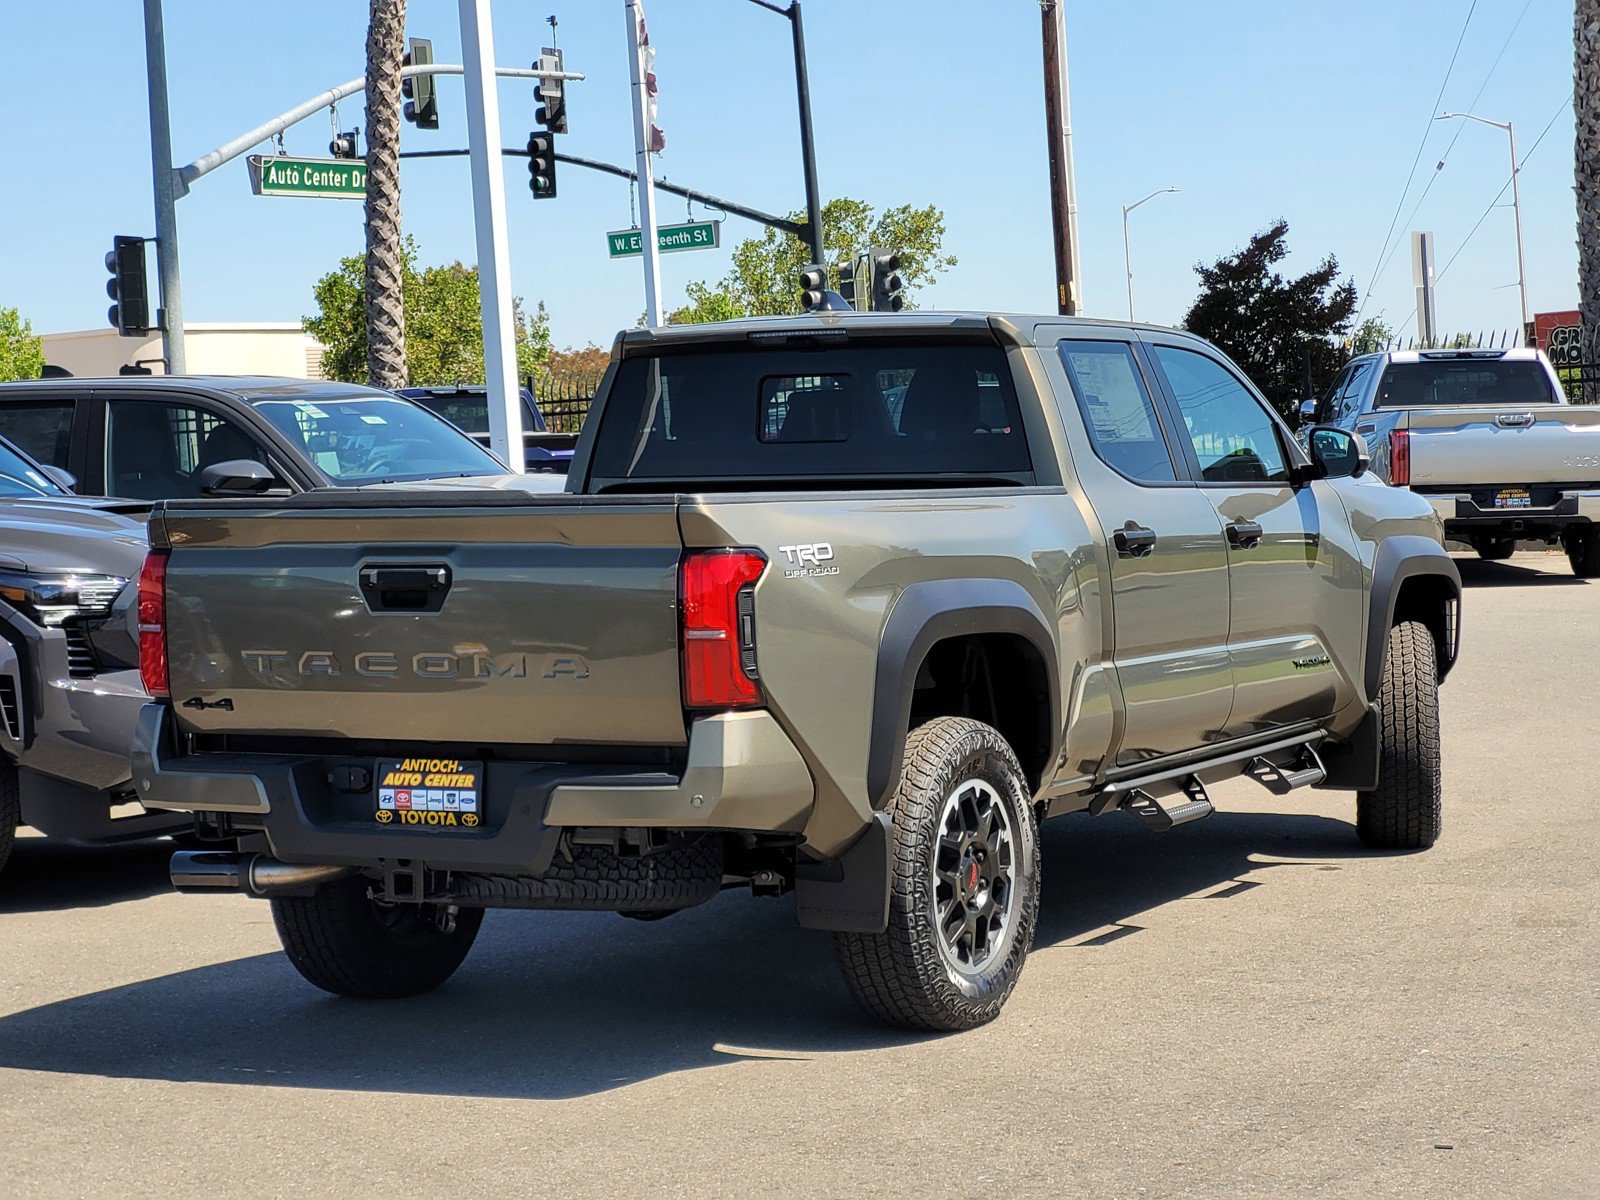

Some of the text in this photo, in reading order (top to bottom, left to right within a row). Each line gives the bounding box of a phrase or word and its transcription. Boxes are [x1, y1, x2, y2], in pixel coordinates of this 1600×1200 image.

[269, 166, 367, 188] Auto Center Dr
[614, 229, 708, 251] W. Eieenth St
[778, 542, 833, 567] TRD
[808, 566, 840, 577] ROAD
[241, 649, 590, 680] TACOMA
[400, 758, 459, 773] ANTIOCH
[382, 772, 476, 788] AUTO CENTER
[398, 810, 458, 826] TOYOTA
[985, 896, 1032, 993] WRANGLER
